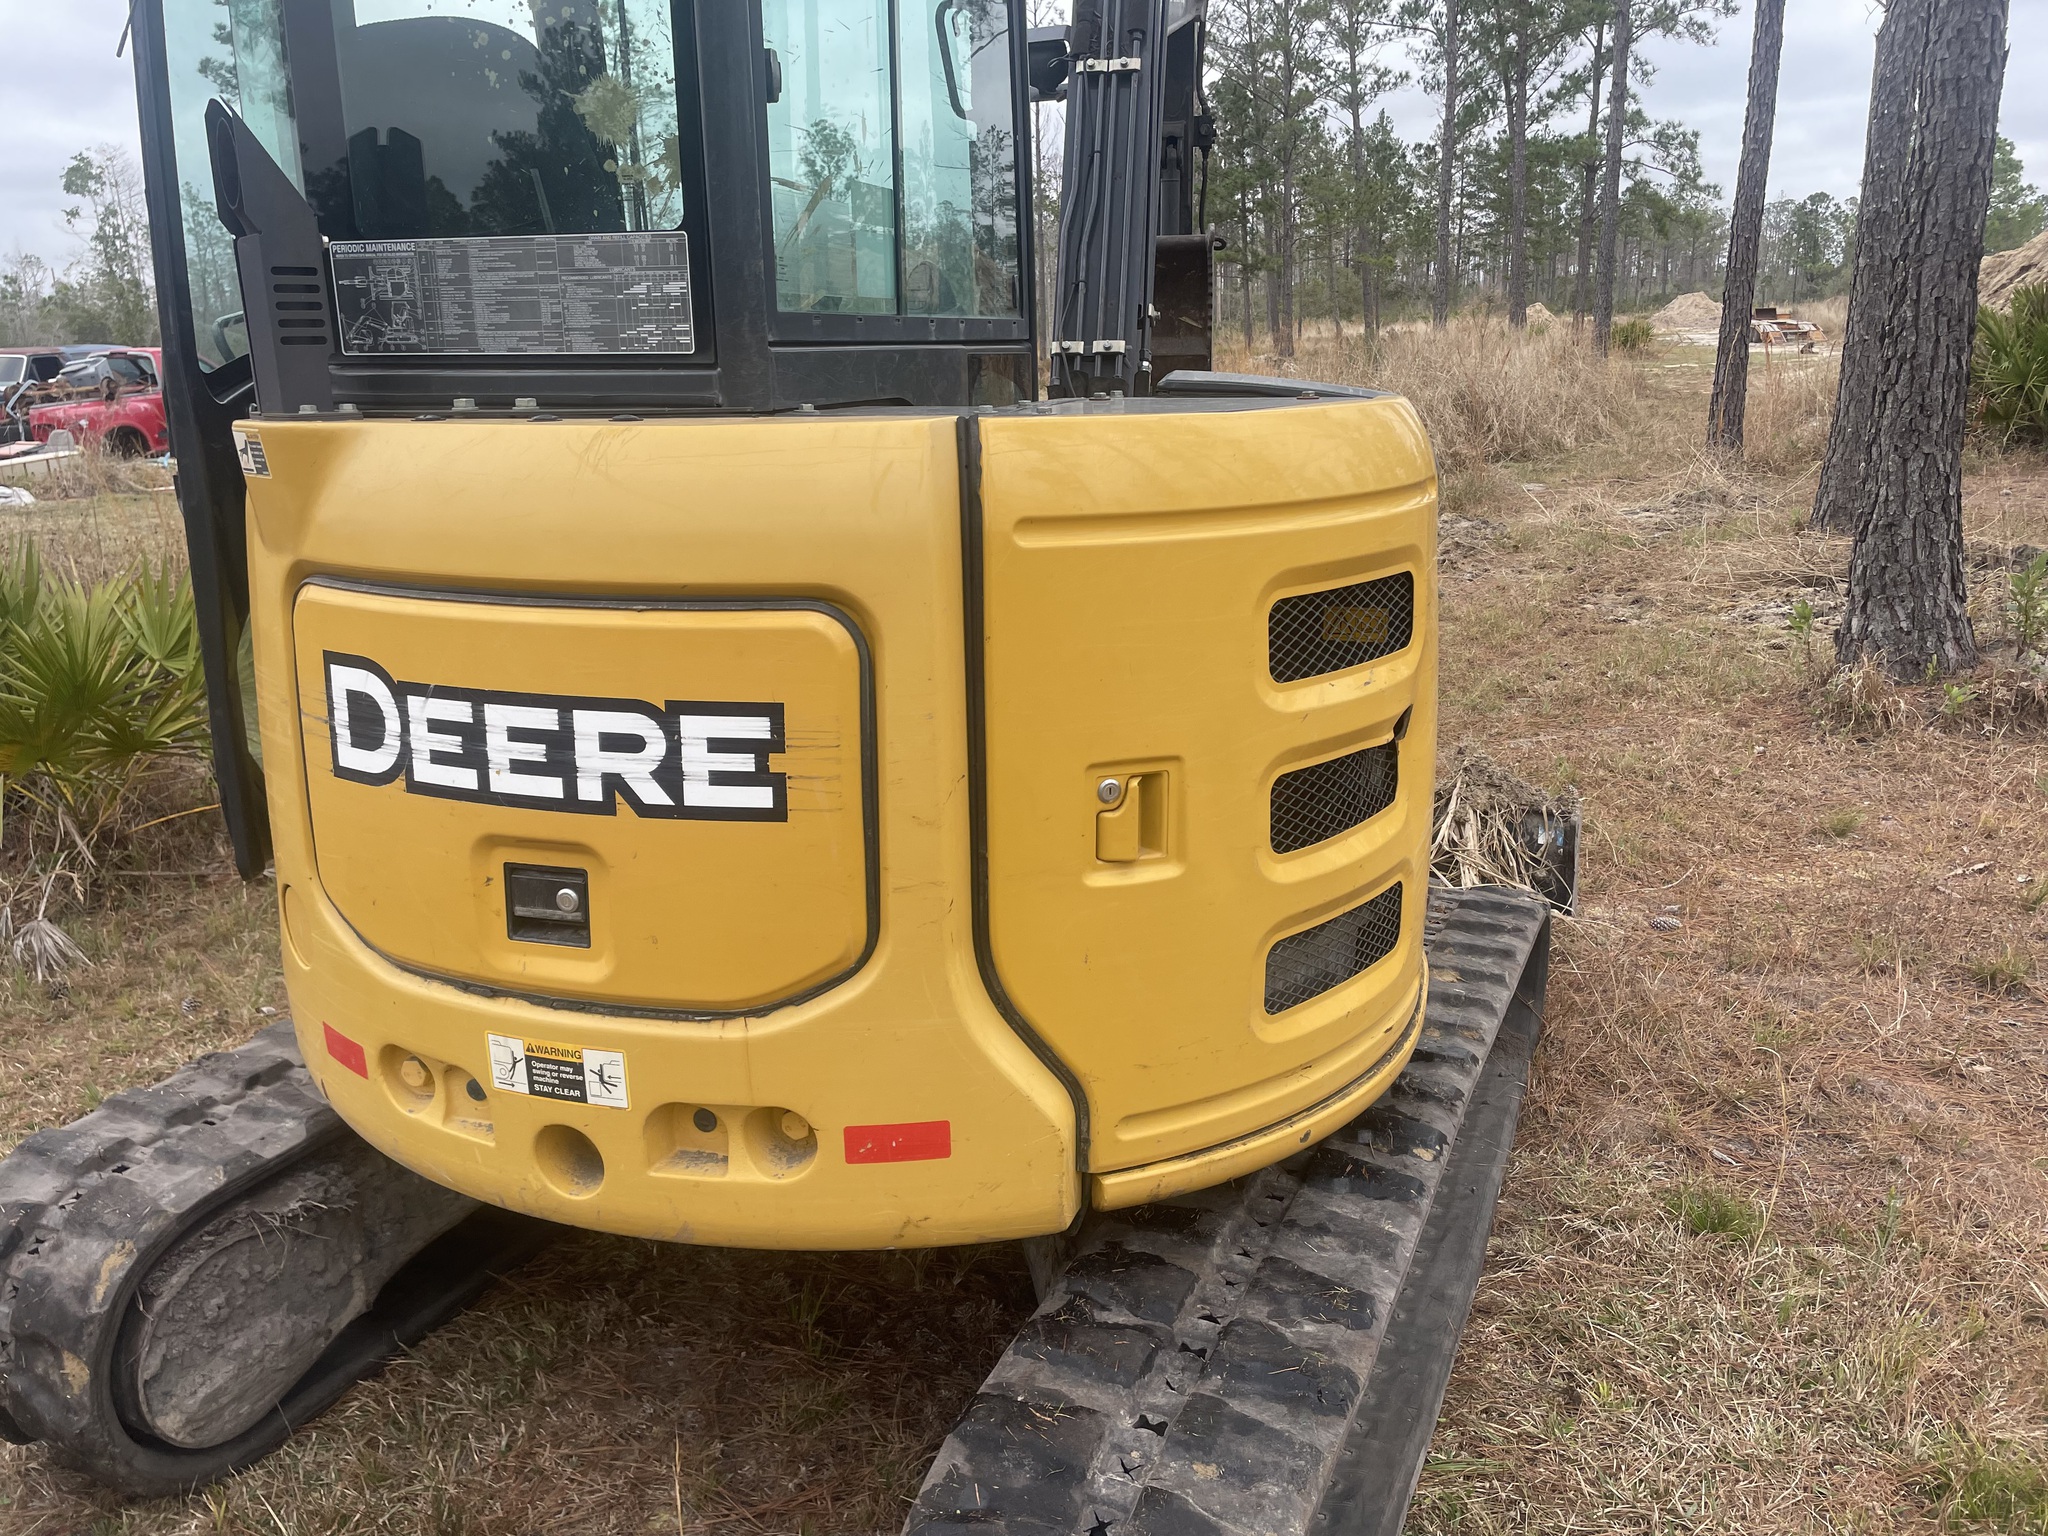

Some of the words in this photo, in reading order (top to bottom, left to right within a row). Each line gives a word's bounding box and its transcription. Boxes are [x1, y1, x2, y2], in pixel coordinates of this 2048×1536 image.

[332, 243, 365, 253] PERIODIC
[366, 242, 416, 252] MAINTENANCE
[328, 662, 776, 810] DEERE
[535, 1045, 582, 1060] WARNING
[531, 1060, 558, 1071] Operator
[560, 1065, 574, 1074] may
[532, 1069, 551, 1078] swing
[560, 1073, 584, 1081] reverse
[532, 1076, 560, 1085] machine
[534, 1084, 553, 1093] STAY
[554, 1087, 581, 1098] CLEAR
